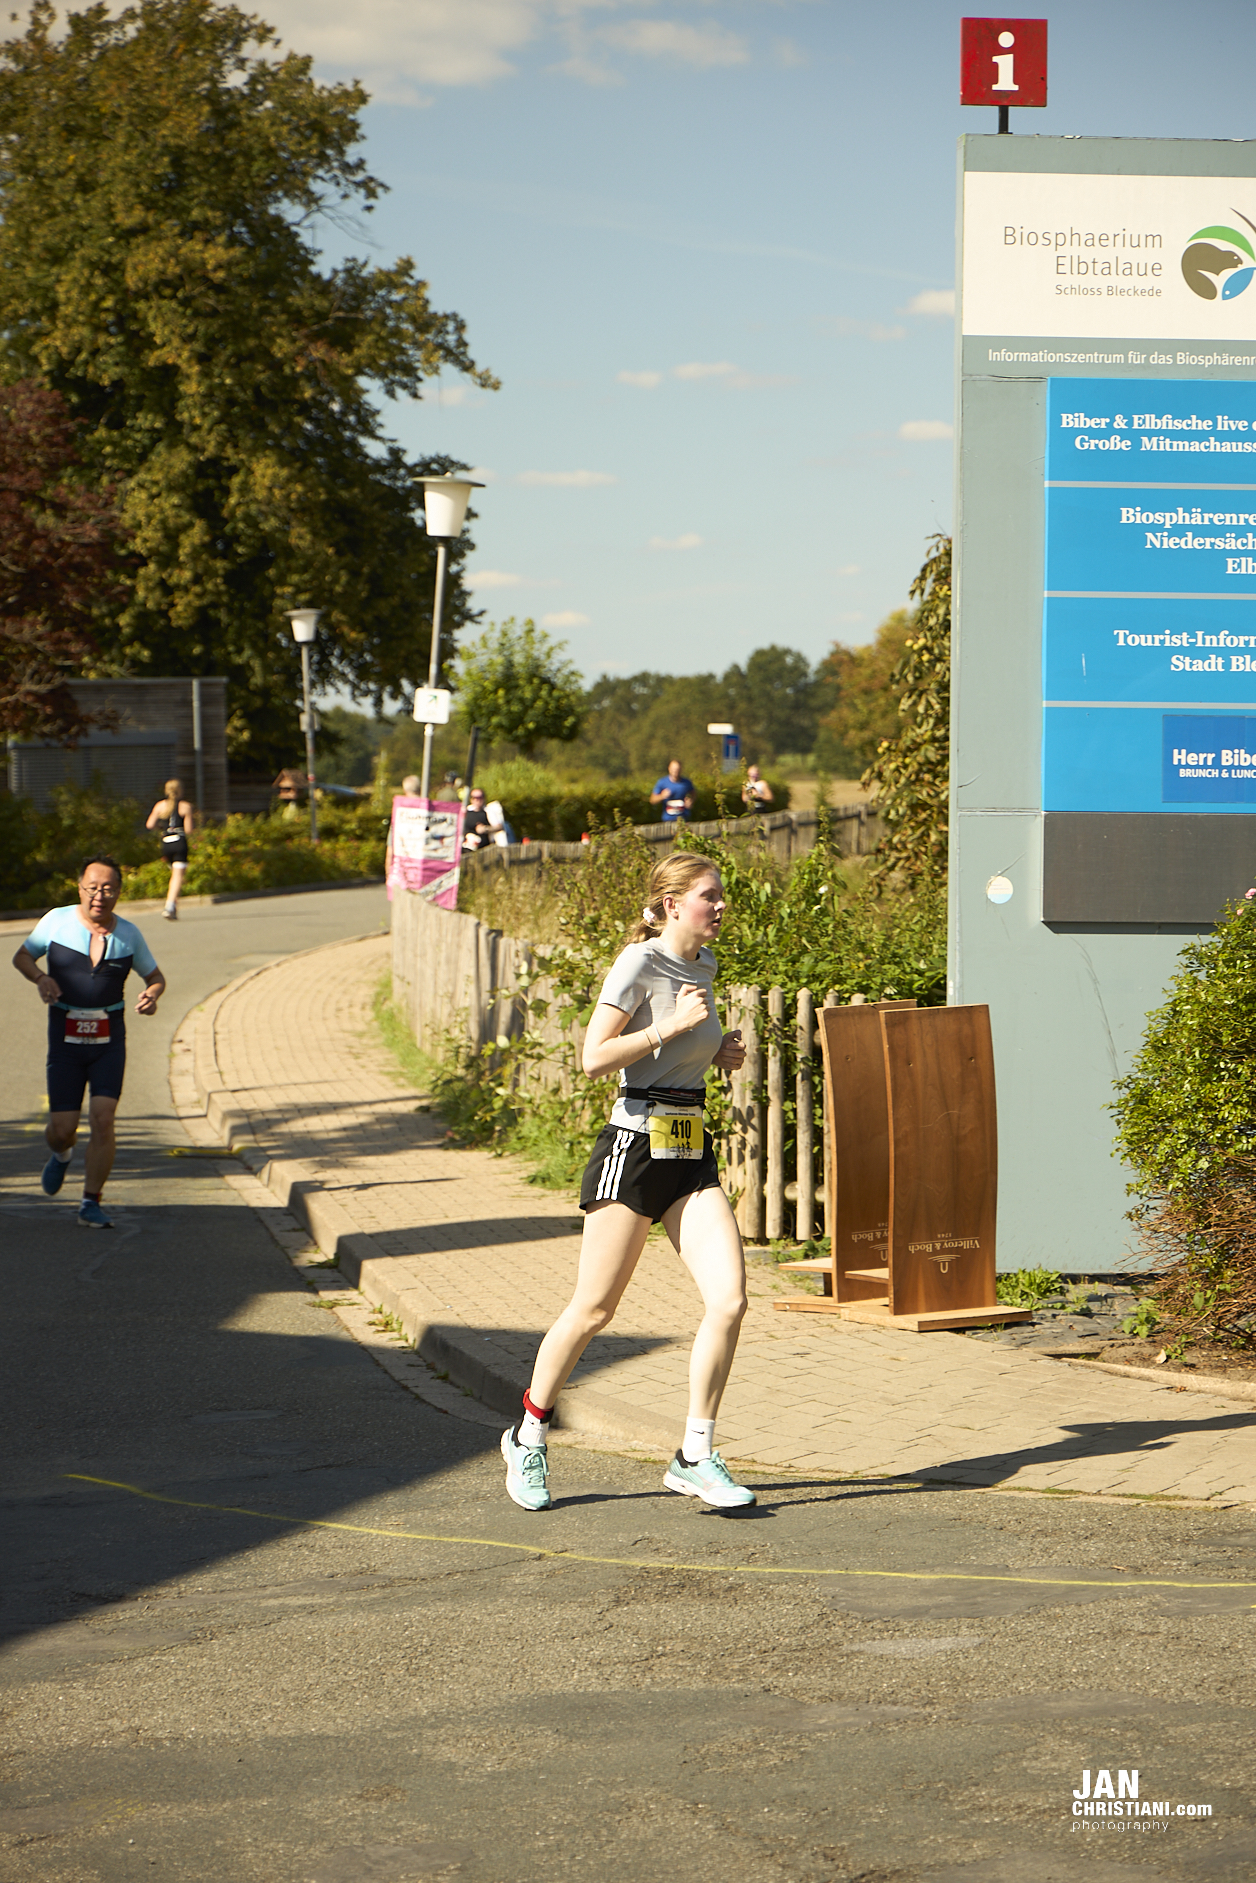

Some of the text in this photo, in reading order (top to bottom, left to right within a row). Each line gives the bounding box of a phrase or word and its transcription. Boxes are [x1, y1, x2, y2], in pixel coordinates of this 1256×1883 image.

[992, 31, 1019, 91] i
[1003, 226, 1163, 252] Biosphaerium
[1055, 255, 1163, 277] Elbtalaue
[1055, 284, 1162, 297] Schloss Bleckede
[988, 349, 1256, 368] Informationszentrum für das Biosphärenr
[1060, 413, 1110, 429] Biber
[1113, 414, 1129, 429] &
[1132, 414, 1213, 431] Elbfische
[1216, 415, 1249, 431] live
[1075, 435, 1132, 451] Große
[1120, 507, 1256, 527] Biosphärenre
[1145, 532, 1256, 550] Niedersäch
[1226, 557, 1256, 574] Elb
[1170, 654, 1225, 672] Stadt
[1172, 748, 1216, 765] Herr
[1179, 768, 1256, 779] BRUNCH & LUNC
[76, 1021, 98, 1033] 252
[670, 1119, 692, 1139] 410
[851, 1232, 874, 1243] Boch
[908, 1239, 980, 1254] Villeroy & Boch
